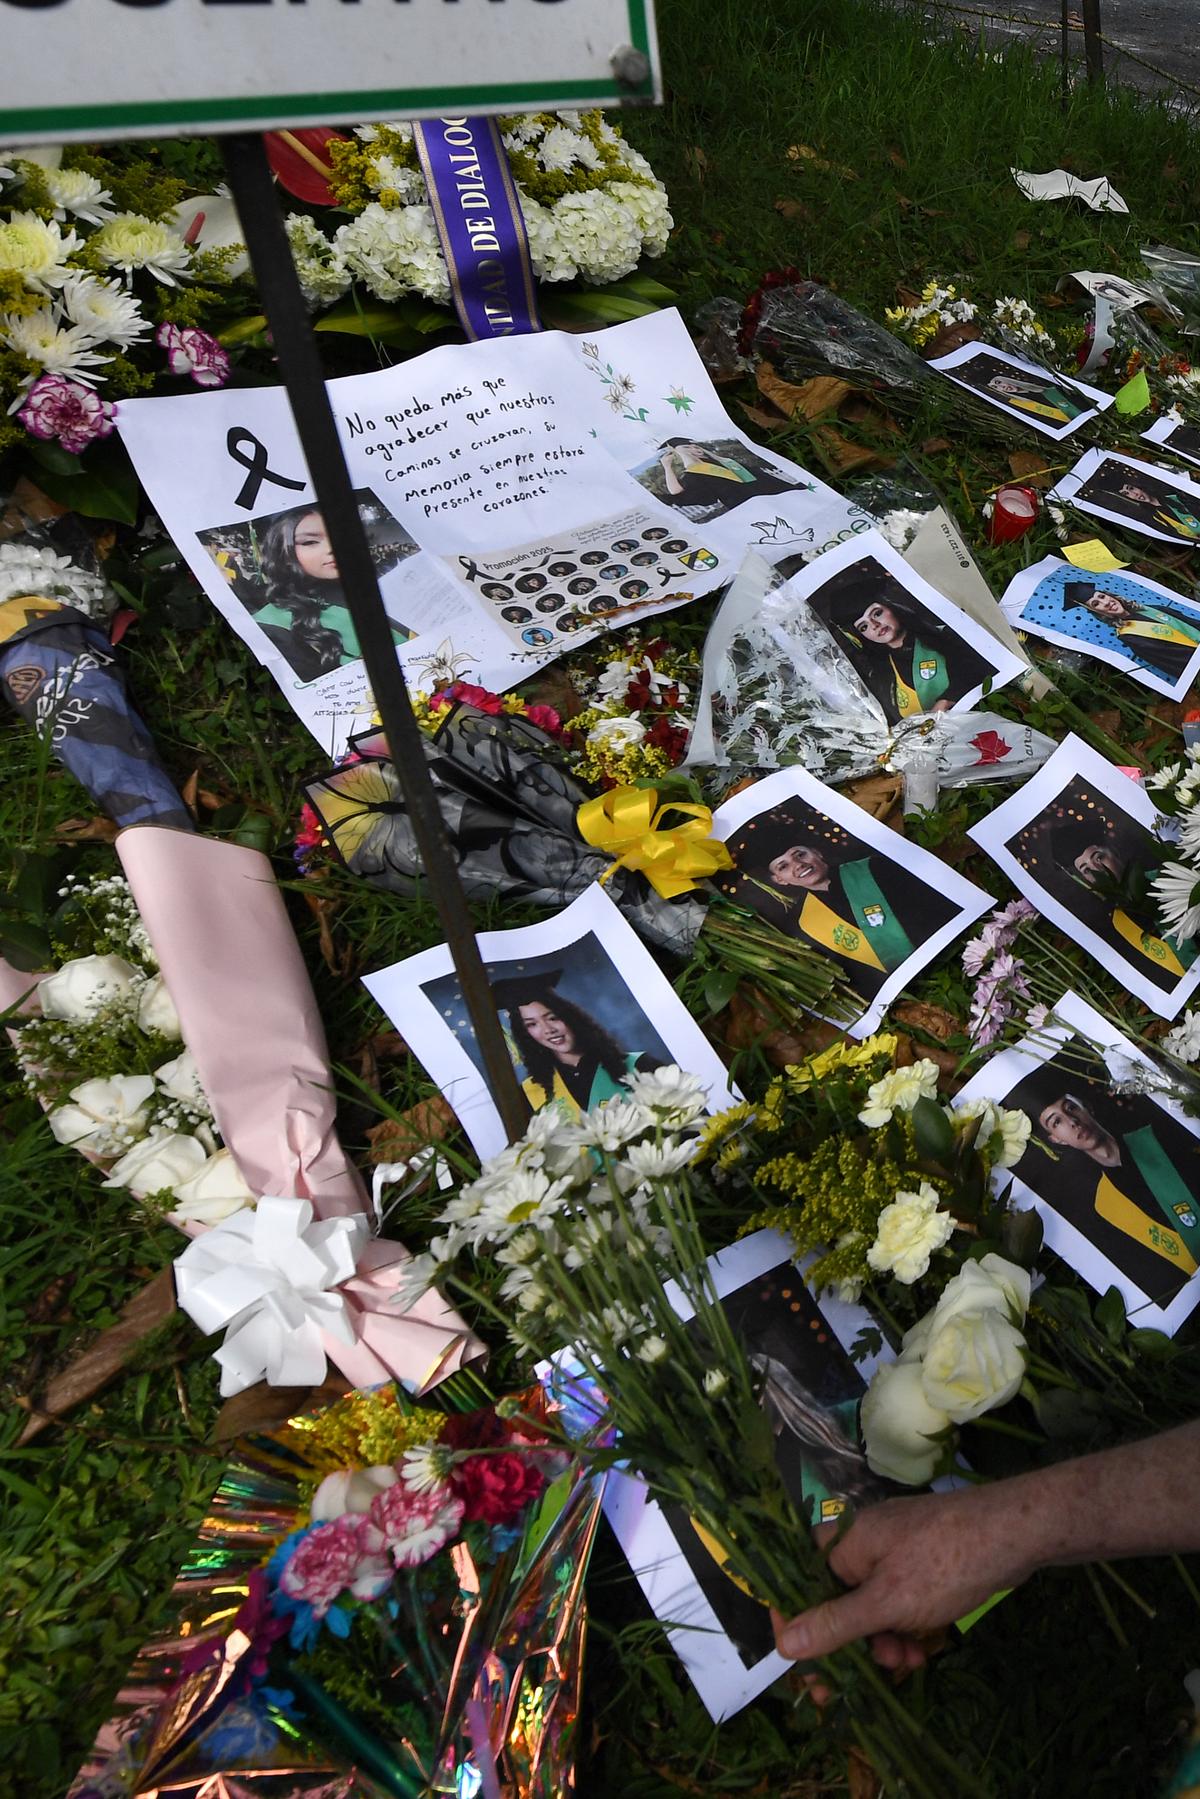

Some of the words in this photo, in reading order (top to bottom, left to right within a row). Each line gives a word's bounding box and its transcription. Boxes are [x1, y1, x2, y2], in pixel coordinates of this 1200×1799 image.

[466, 216, 500, 252] DE
[345, 412, 376, 438] No
[384, 396, 434, 430] queda
[482, 376, 506, 397] que
[365, 420, 448, 461] agradecer
[466, 407, 492, 426] que
[499, 391, 555, 413] nuestros
[449, 447, 462, 460] se
[544, 420, 557, 432] su
[479, 451, 535, 475] siempre
[424, 487, 483, 518] presente
[496, 480, 510, 491] en
[483, 553, 531, 571] Promoción
[529, 546, 554, 558] 2025
